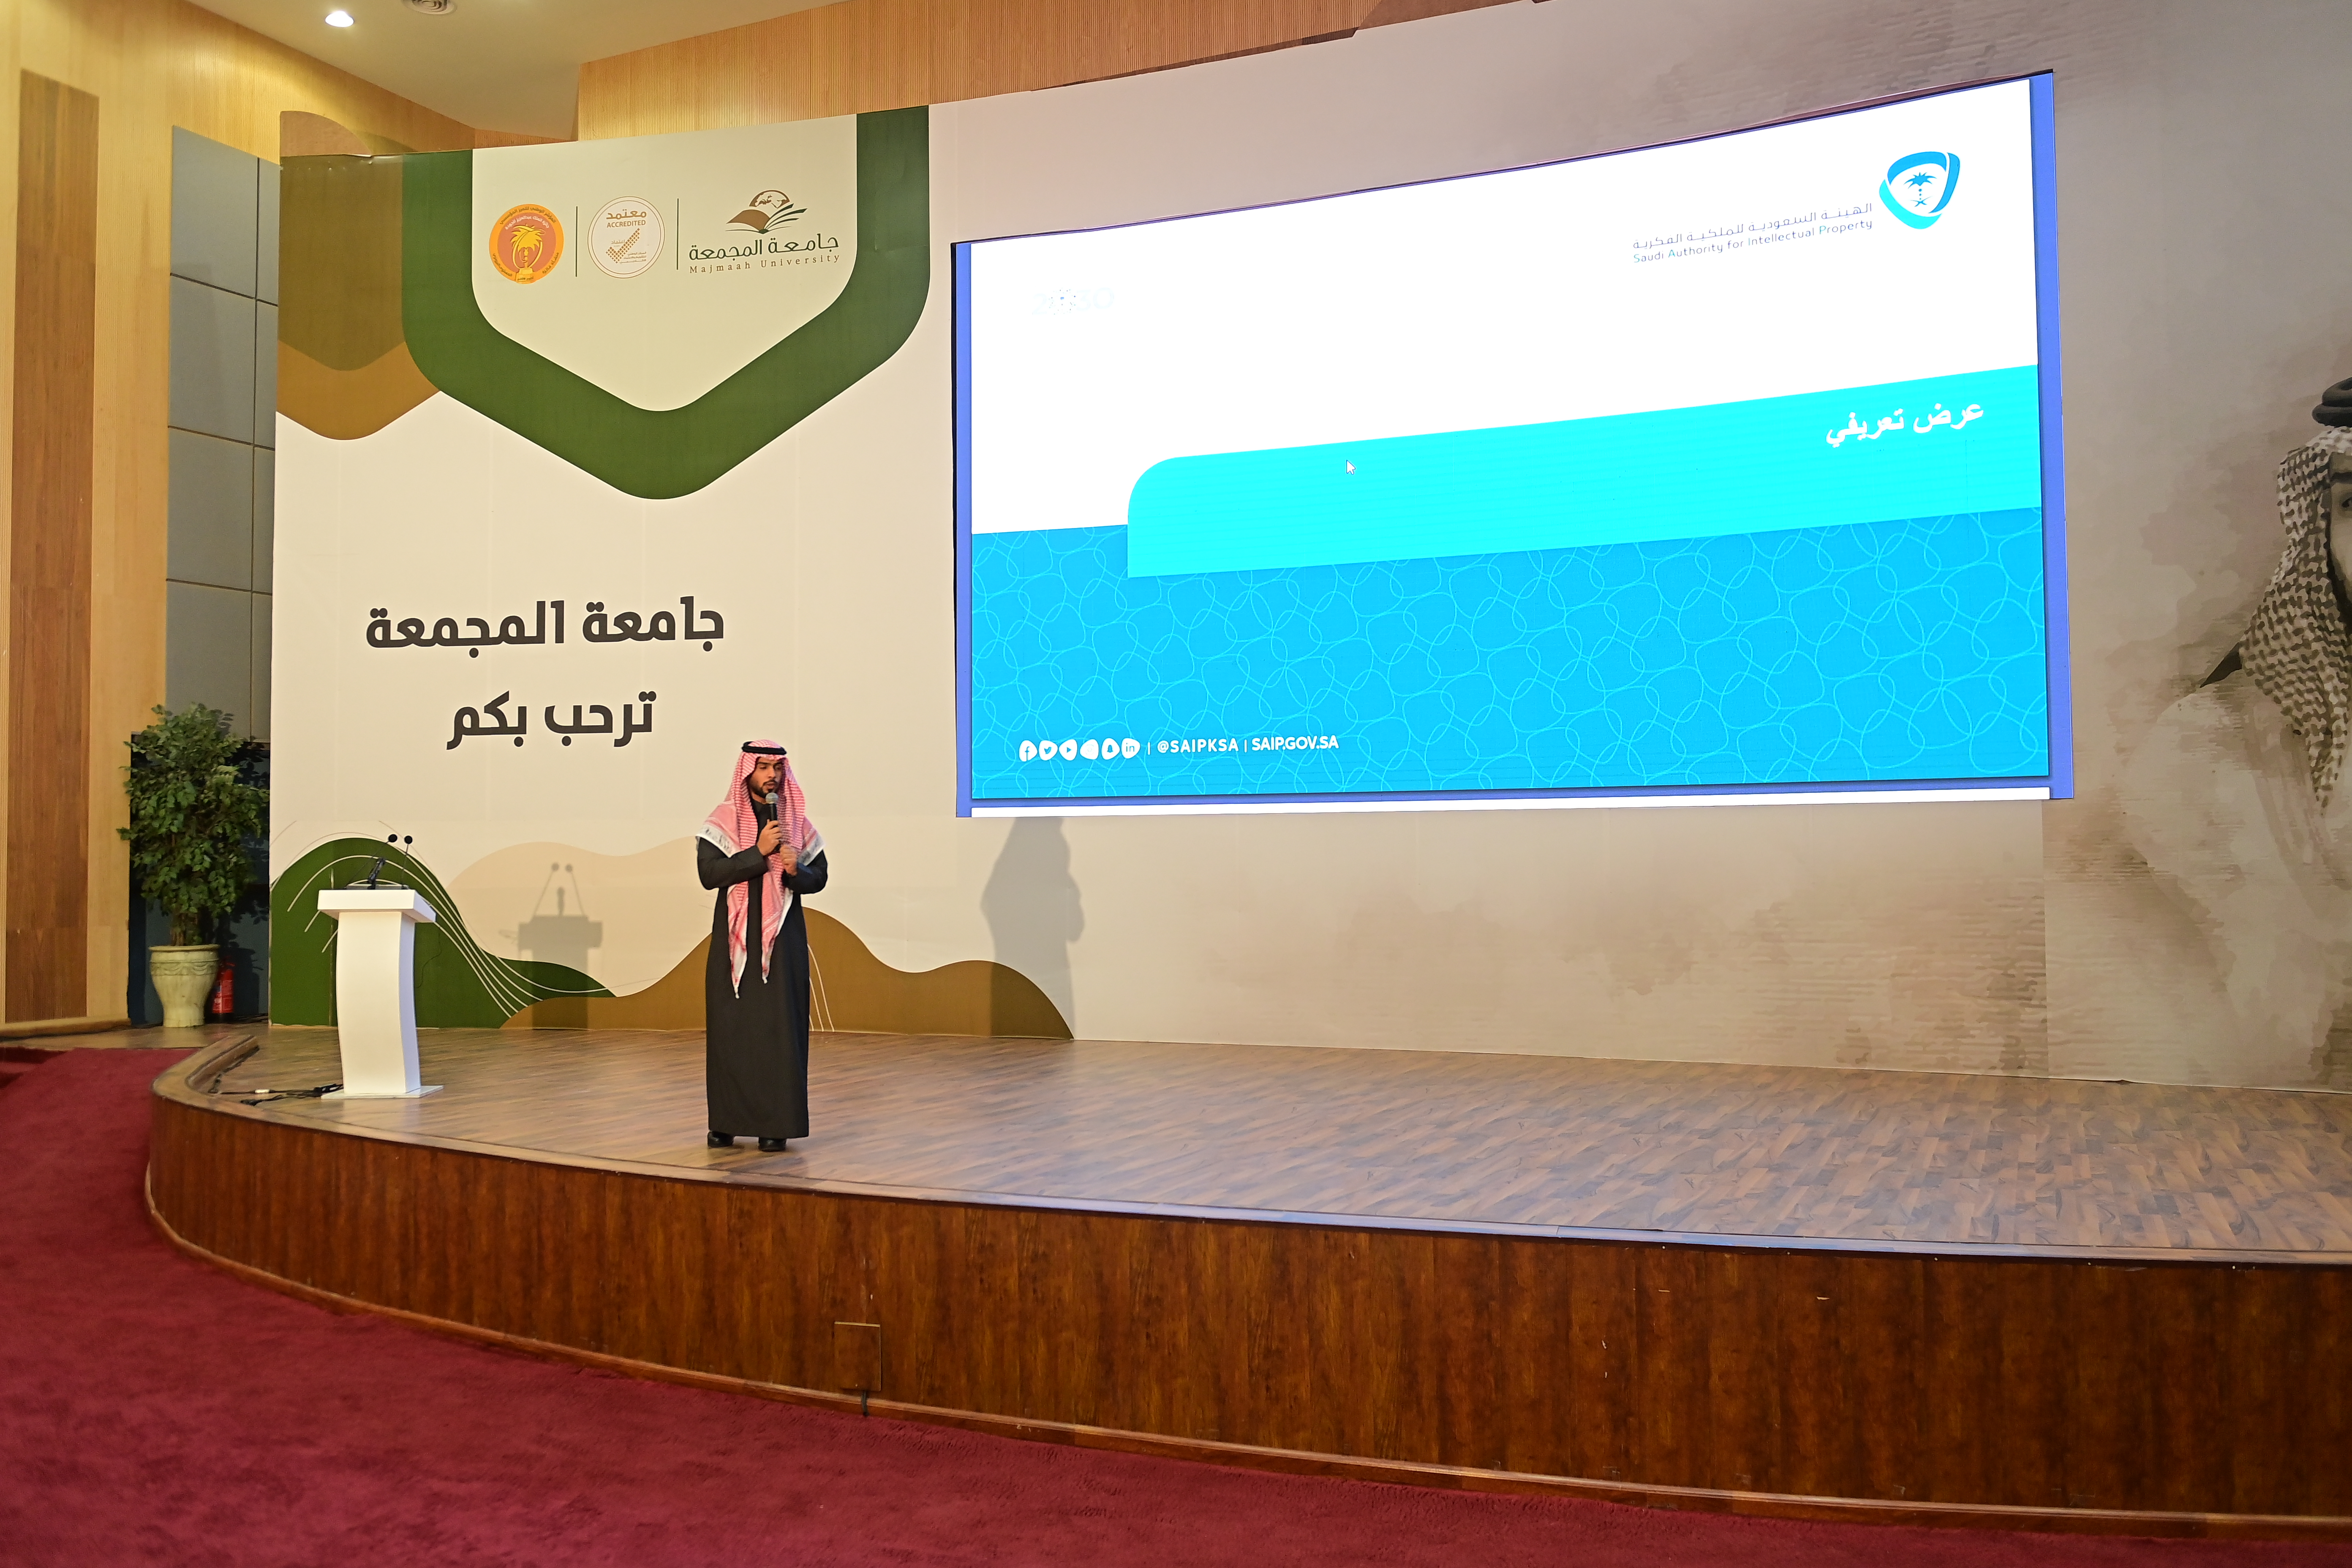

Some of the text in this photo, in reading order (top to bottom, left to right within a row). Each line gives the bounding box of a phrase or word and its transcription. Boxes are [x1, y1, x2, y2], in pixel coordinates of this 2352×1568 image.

[606, 209, 647, 220] معتمد
[607, 220, 646, 228] ACCREDITED
[1749, 212, 1816, 231] السعودية
[1633, 234, 1682, 249] الفكرية
[1633, 220, 1872, 263] Saudi Authority for Intellectual Property
[1687, 224, 1743, 242] للملكية
[689, 233, 839, 261] جامعة المجمعة
[689, 254, 840, 274] Majmaah University
[1826, 403, 1984, 448] عرض تعريفي
[366, 596, 724, 659] جامعة المجمعة
[446, 690, 657, 751] ترحب بكم
[1126, 743, 1135, 752] in
[1157, 738, 1239, 754] @SAIPKSA
[1251, 735, 1339, 751] SAIP.GOV.SA
